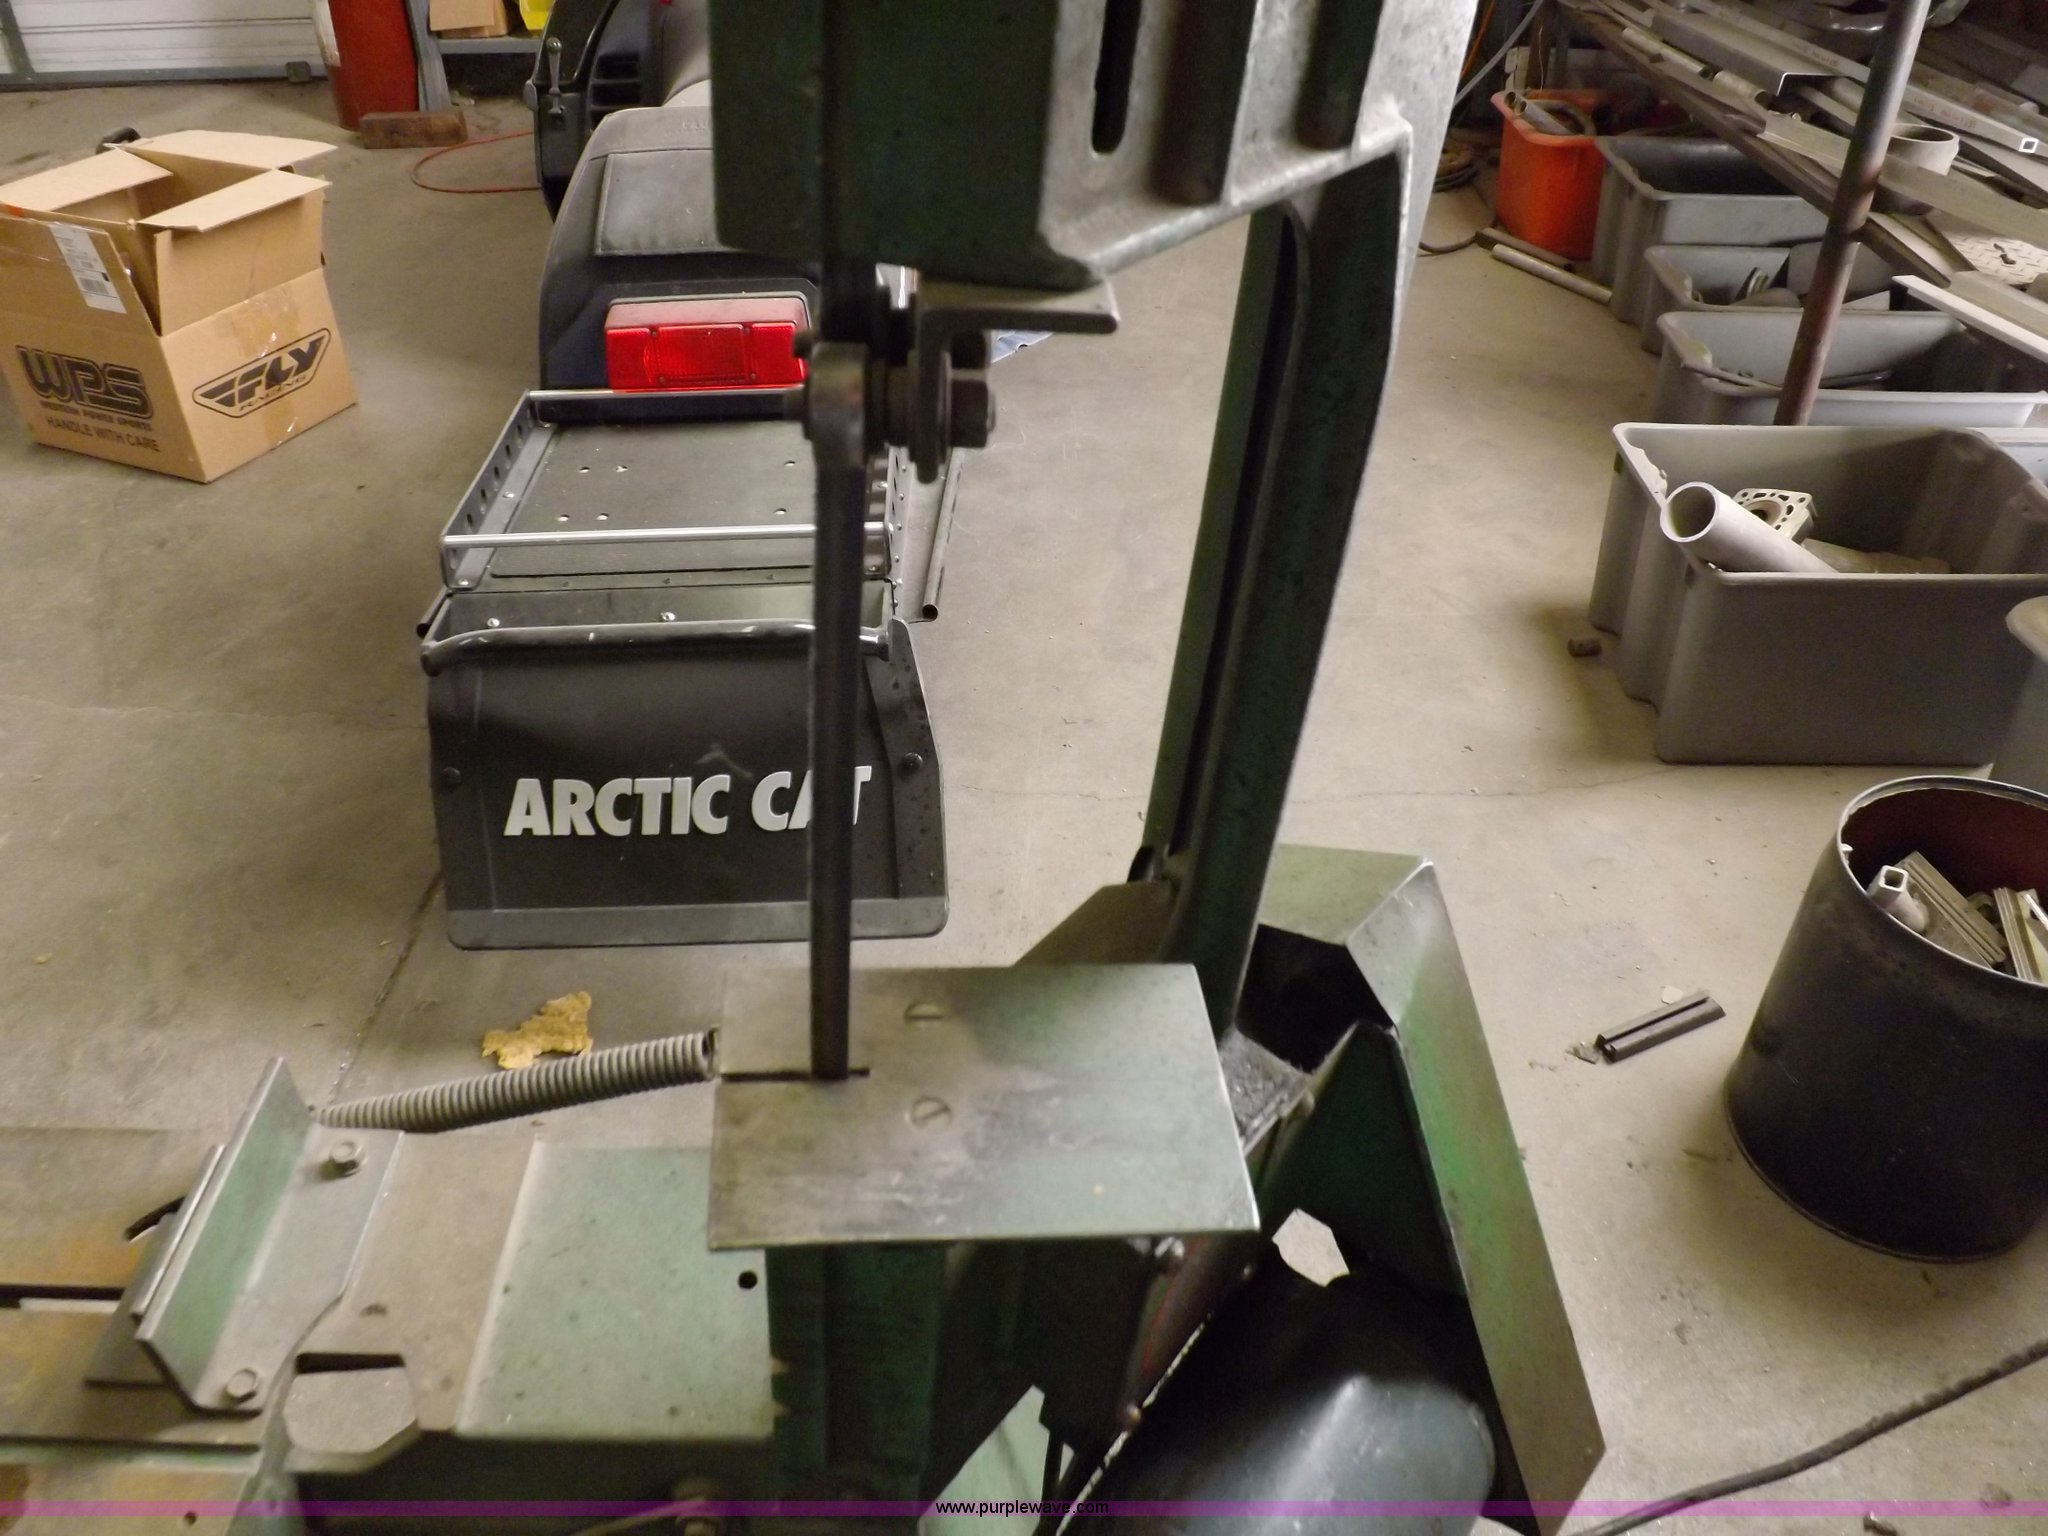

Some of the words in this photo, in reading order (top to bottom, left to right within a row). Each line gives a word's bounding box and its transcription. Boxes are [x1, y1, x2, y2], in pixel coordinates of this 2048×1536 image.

[15, 344, 154, 420] WPS
[199, 335, 326, 408] FLY
[46, 415, 94, 437] HANDLE
[95, 426, 126, 444] WITH
[126, 432, 161, 453] CARE
[503, 773, 731, 837] ARCTIC
